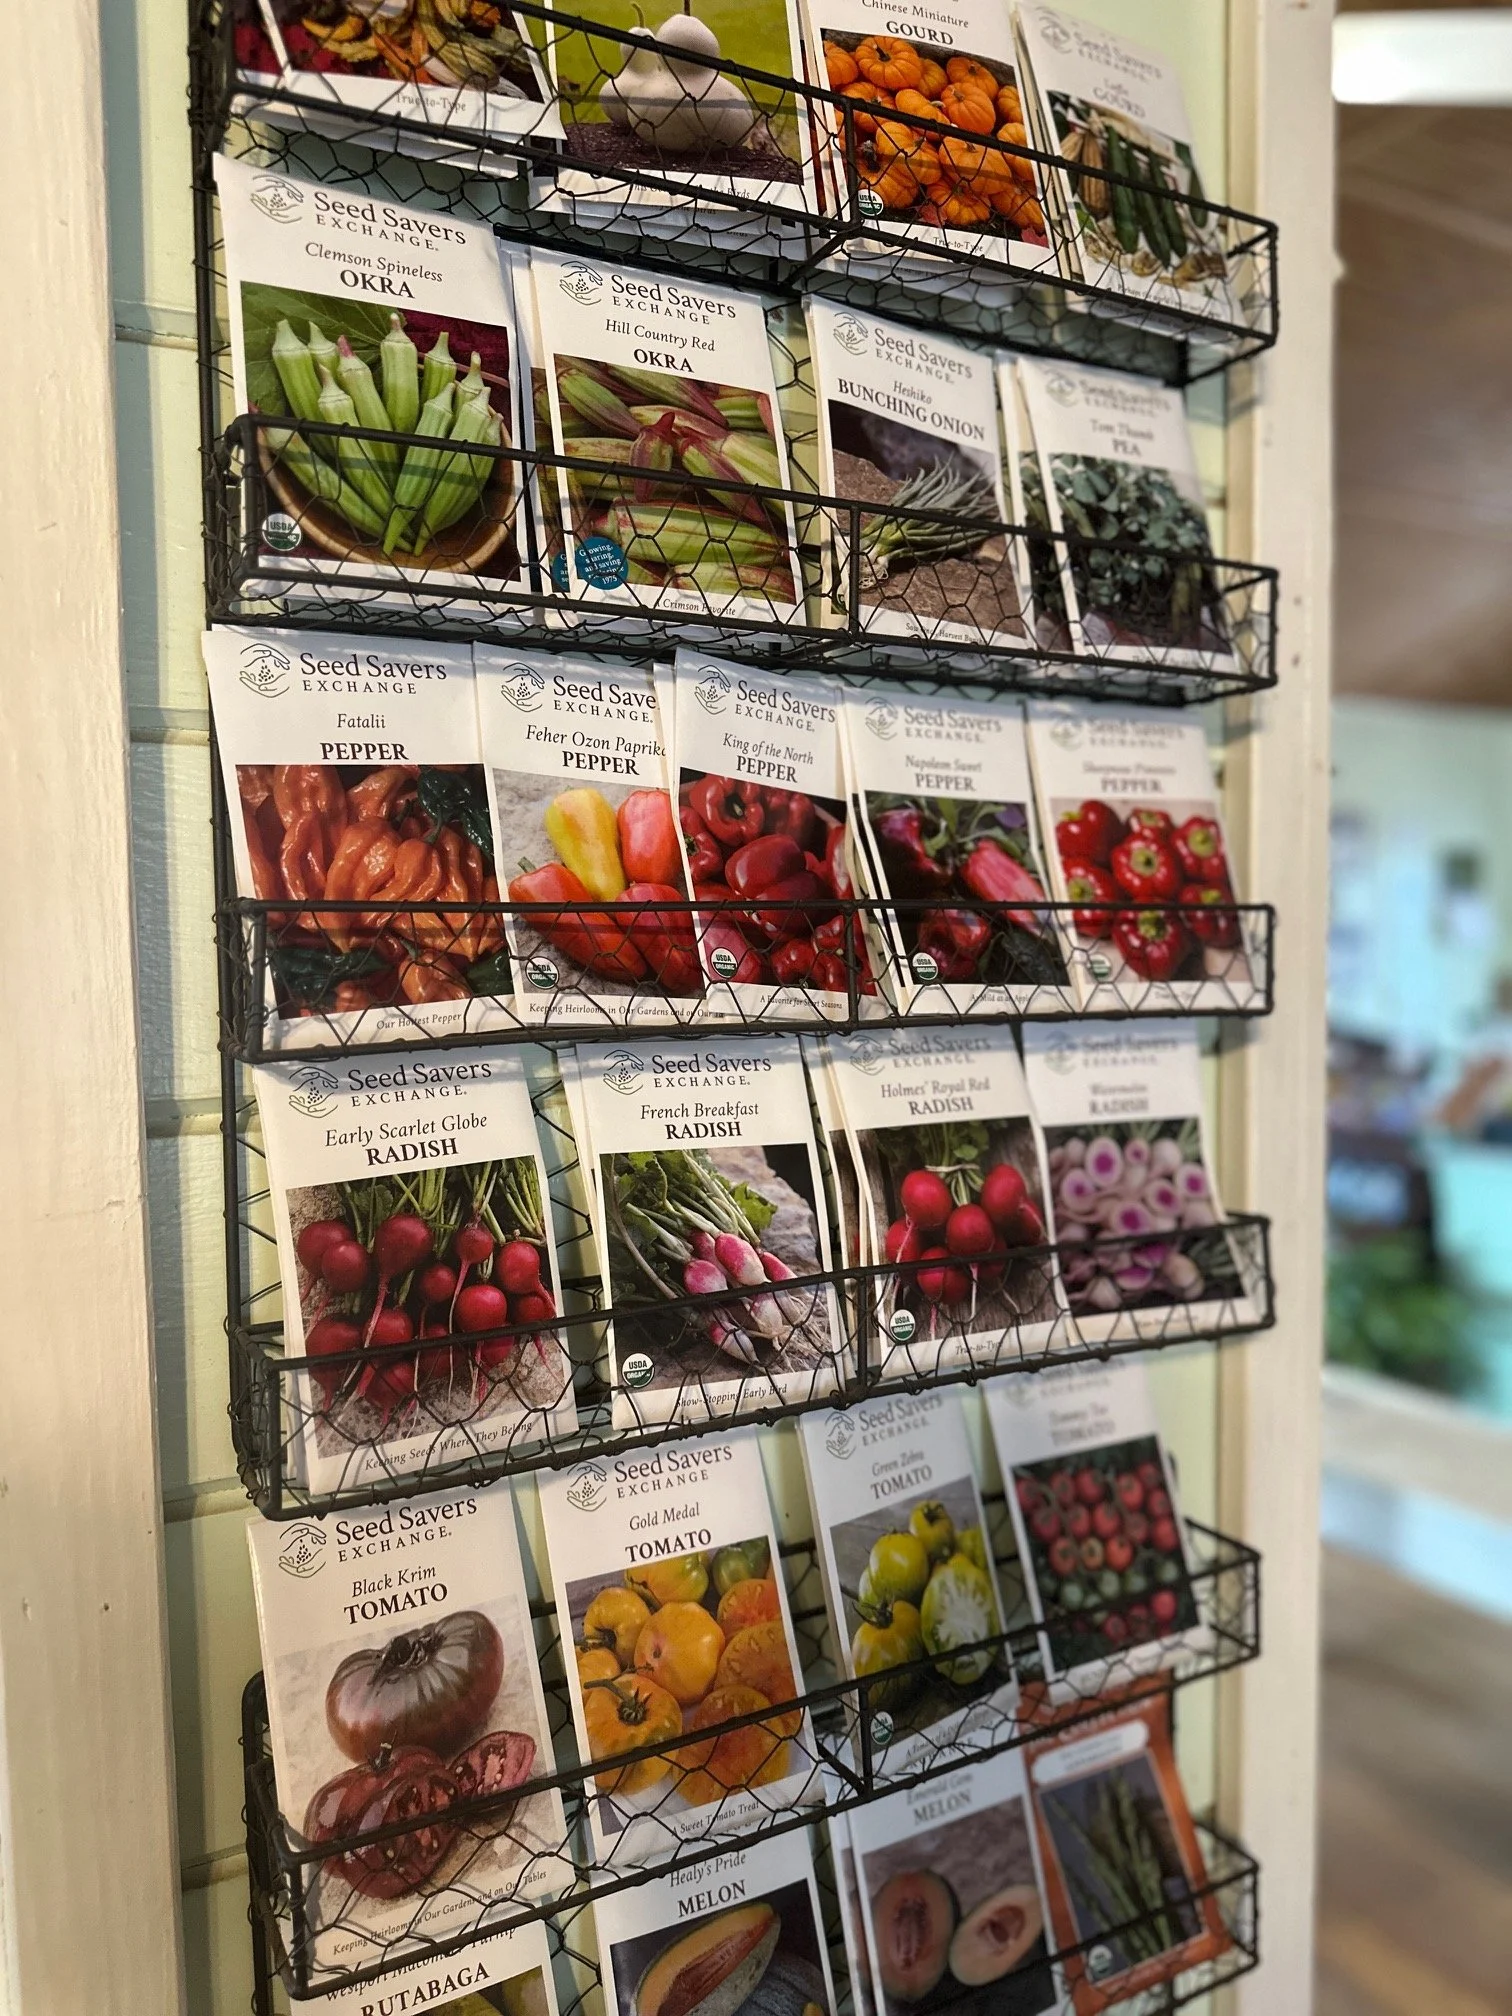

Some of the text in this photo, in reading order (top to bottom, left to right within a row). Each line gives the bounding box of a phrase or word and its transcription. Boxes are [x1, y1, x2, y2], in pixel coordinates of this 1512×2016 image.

[912, 5, 969, 28] Miniature
[886, 20, 954, 45] GOURD
[396, 94, 466, 113] Trueto-Type
[859, 194, 877, 202] USA
[314, 191, 466, 245] Seed Savers
[305, 242, 443, 283] Clemson Spineless
[339, 269, 415, 299] OKRA
[611, 274, 737, 319] Seed Savers
[605, 319, 715, 351] Hill Country Red
[633, 348, 695, 373] OKRA
[874, 327, 973, 379] Seed Savers
[893, 380, 932, 404] Heshiko
[838, 378, 985, 441] BUNCHING ONION
[1112, 439, 1142, 457] PEA
[579, 544, 613, 557] Gowing,
[586, 552, 614, 563] saring,
[602, 575, 618, 584] 1975
[663, 599, 700, 612] Crimson
[300, 652, 447, 680] Seed Savers
[303, 679, 417, 695] EXCHANGE
[553, 675, 659, 710] Seed Save
[737, 680, 836, 724] Seed Savers
[336, 713, 387, 729] Fatalii
[904, 705, 1002, 732] Seed Savers
[526, 724, 568, 746] Feher
[572, 731, 611, 750] Ozon
[723, 733, 814, 765] King of the North
[320, 742, 409, 761] PEPPER
[562, 750, 641, 776] PEPPER
[736, 755, 798, 784] PEPPER
[915, 773, 977, 792] PEPPER
[715, 953, 732, 963] USDA
[608, 1006, 616, 1014] in
[619, 1006, 635, 1015] Or
[637, 1006, 669, 1016] Gardens
[760, 995, 766, 1003] A
[376, 1020, 395, 1030] Our
[432, 1014, 461, 1025] Pepper
[888, 1034, 991, 1055] Seed Savers
[348, 1062, 492, 1091] Seed Savers
[652, 1053, 772, 1075] Seed Savers
[932, 1079, 966, 1096] Royal
[969, 1077, 990, 1092] Red
[640, 1101, 760, 1120] French Breakfast
[909, 1096, 974, 1116] RADISH
[325, 1113, 488, 1147] Early Scarlet Globe
[665, 1121, 742, 1140] RADISH
[365, 1138, 459, 1167] RADISH
[895, 1316, 910, 1324] USDA
[628, 1360, 647, 1369] USDA
[743, 1387, 767, 1399] Early
[859, 1393, 944, 1431] Seed Savers
[440, 1438, 471, 1451] Where
[474, 1429, 498, 1444] They
[615, 1445, 732, 1483] Seed Savers
[872, 1460, 899, 1477] Green
[617, 1470, 709, 1499] EXCHANGE
[870, 1464, 933, 1500] TOMATO
[336, 1498, 477, 1545] Seed Savers
[629, 1502, 700, 1531] Gold Medal
[625, 1528, 712, 1563] TOMATO
[352, 1564, 436, 1598] Black Krim
[344, 1583, 448, 1625] TOMATO
[680, 1821, 704, 1834] Sweet
[707, 1810, 736, 1827] Tmato
[738, 1801, 760, 1816] Treat
[913, 1790, 972, 1826] MELON
[670, 1850, 747, 1888] Healy's Pride
[678, 1879, 746, 1919] MELON
[333, 1937, 369, 1955] Keeping
[425, 1908, 442, 1921] Our
[494, 1887, 504, 1897] on
[506, 1880, 519, 1892] Ou
[361, 1962, 490, 2016] RUTABAGA
